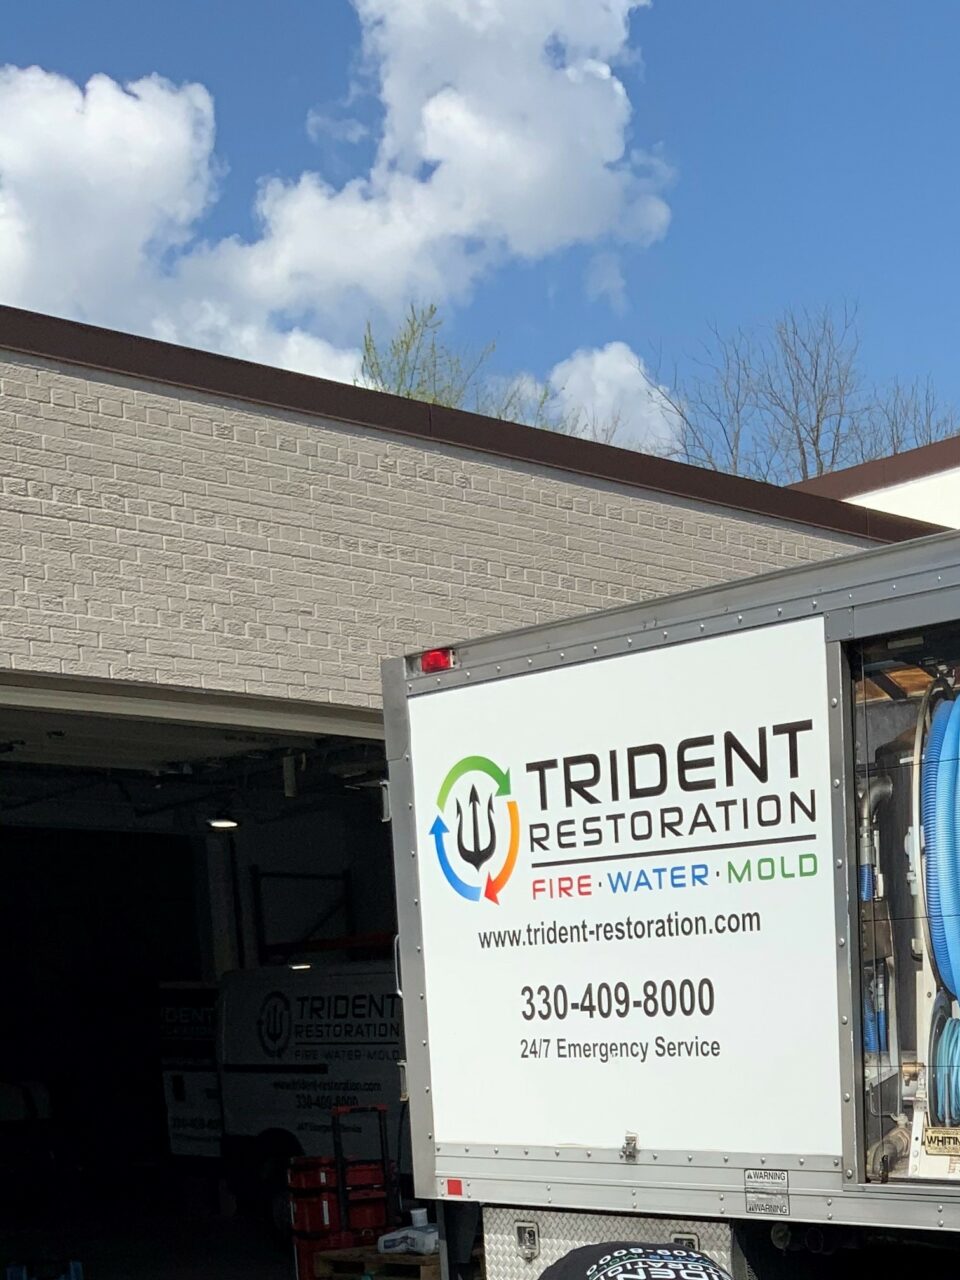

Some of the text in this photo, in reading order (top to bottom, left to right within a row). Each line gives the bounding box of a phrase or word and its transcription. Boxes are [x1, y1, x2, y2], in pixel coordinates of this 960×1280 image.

[526, 719, 813, 811] TRIDENT
[530, 789, 816, 852] RESTORATION
[478, 910, 761, 949] www.trident-restoration.com
[296, 994, 400, 1020] TRIDENT
[520, 977, 715, 1021] 330-409-8000
[295, 1023, 400, 1038] RESTORATION
[520, 1035, 721, 1063] 24/7 Emergency Service
[753, 1171, 786, 1181] WARNING
[754, 1203, 788, 1214] WARNING
